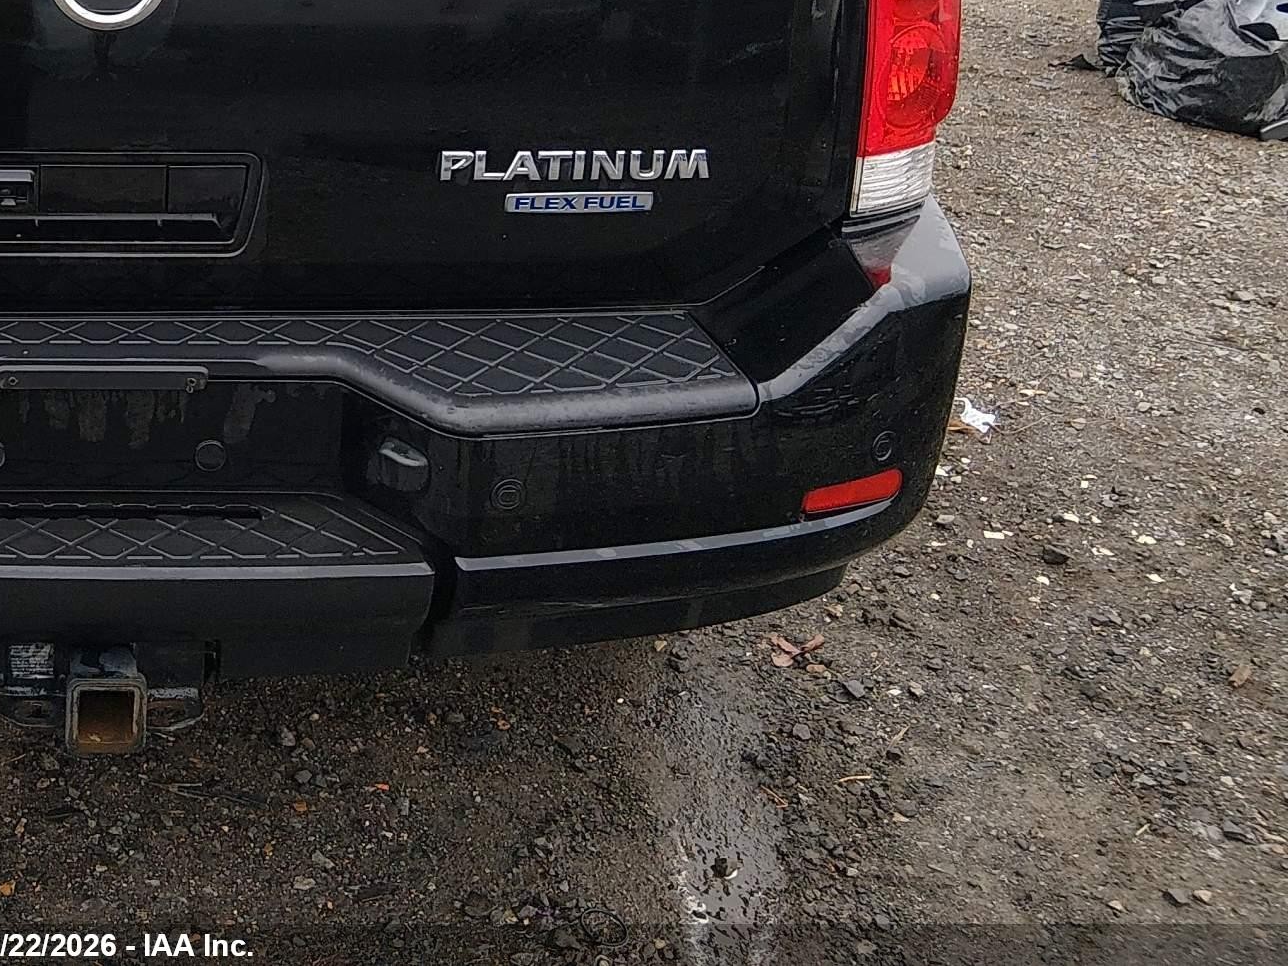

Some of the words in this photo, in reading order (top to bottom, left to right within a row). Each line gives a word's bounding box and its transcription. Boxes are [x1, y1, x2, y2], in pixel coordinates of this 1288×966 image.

[439, 149, 710, 181] PLATINUM
[514, 197, 577, 210] FLEX
[584, 196, 646, 210] FUEL
